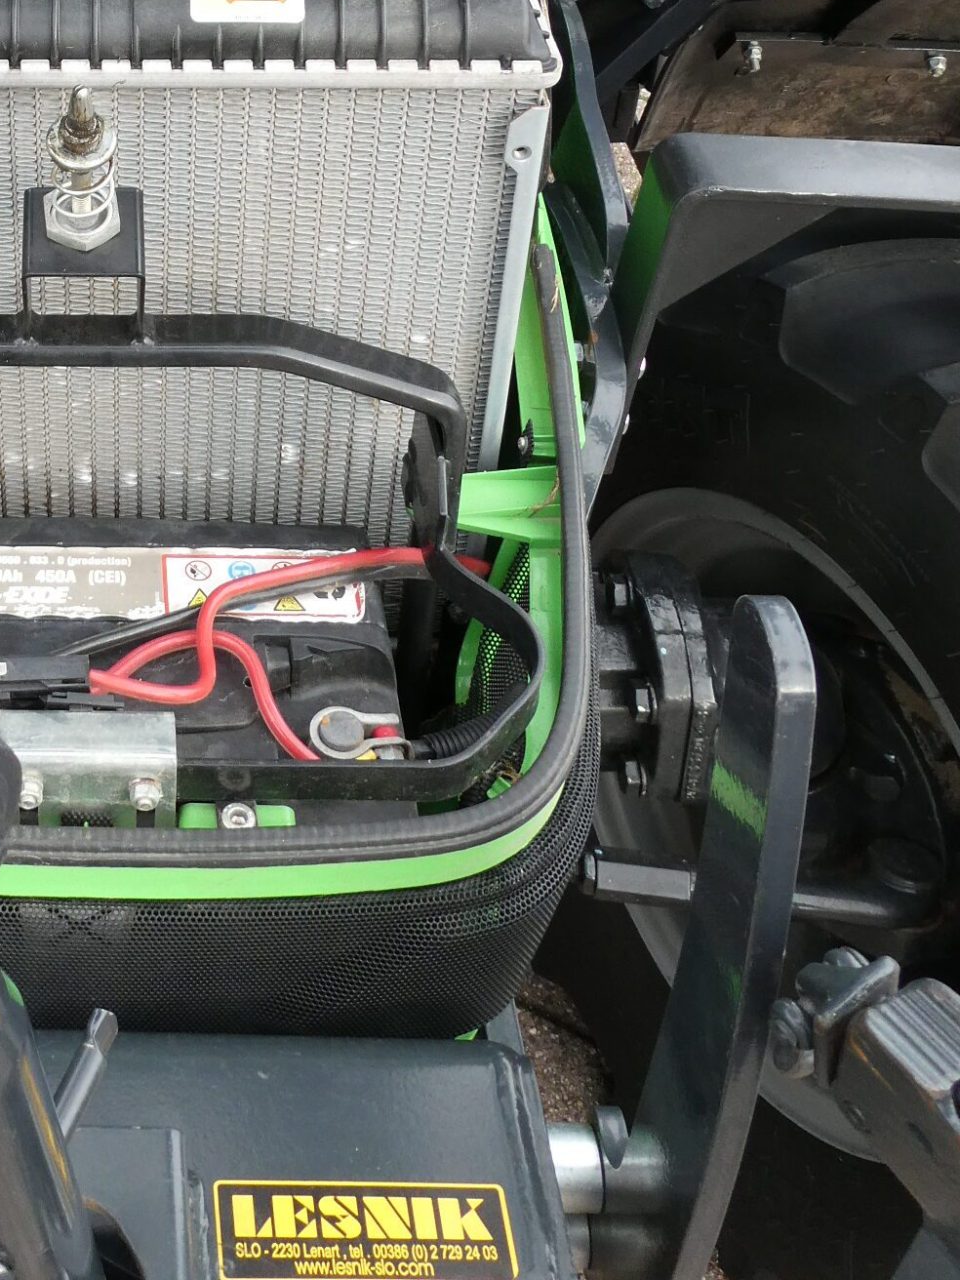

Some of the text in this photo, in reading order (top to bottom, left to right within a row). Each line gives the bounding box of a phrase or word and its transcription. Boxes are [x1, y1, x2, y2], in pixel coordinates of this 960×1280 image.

[88, 569, 127, 586] (CEI)
[231, 1194, 494, 1240] LESNIK
[235, 1242, 262, 1258] SLO
[271, 1242, 301, 1259] 2230
[303, 1242, 341, 1259] Lenart
[372, 1243, 409, 1260] 00386
[412, 1243, 429, 1263] (0)
[430, 1244, 439, 1260] 2
[440, 1244, 463, 1261] 729
[464, 1245, 481, 1261] 24
[482, 1245, 498, 1261] 03
[295, 1258, 435, 1276] www.lesnik-slo.com
